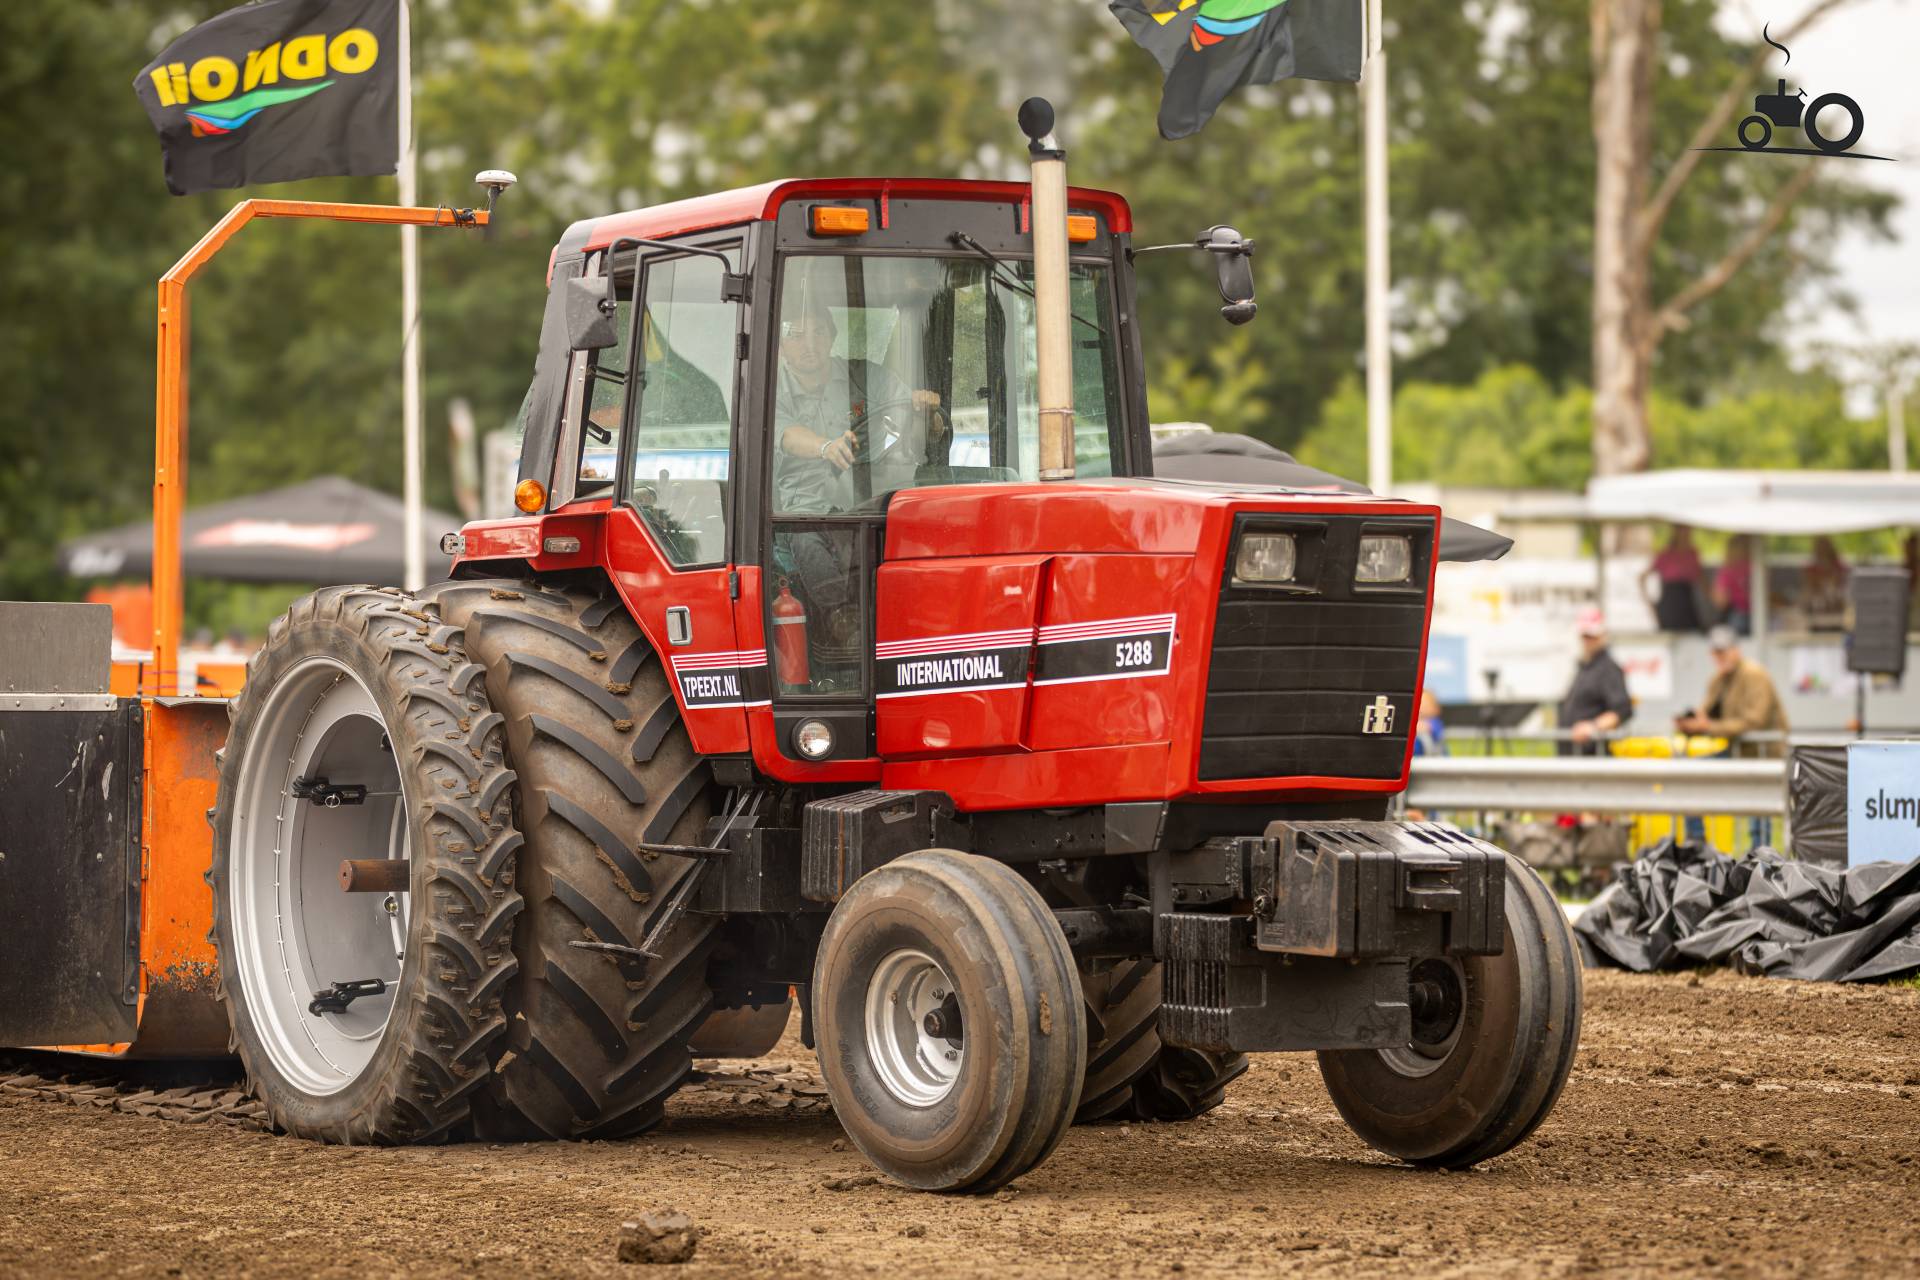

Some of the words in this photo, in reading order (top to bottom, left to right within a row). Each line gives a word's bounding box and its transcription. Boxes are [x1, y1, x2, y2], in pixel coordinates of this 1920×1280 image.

[897, 655, 1003, 686] INTERNATIONAL
[1115, 640, 1152, 667] 5288
[684, 674, 740, 698] TPEEXT.NL
